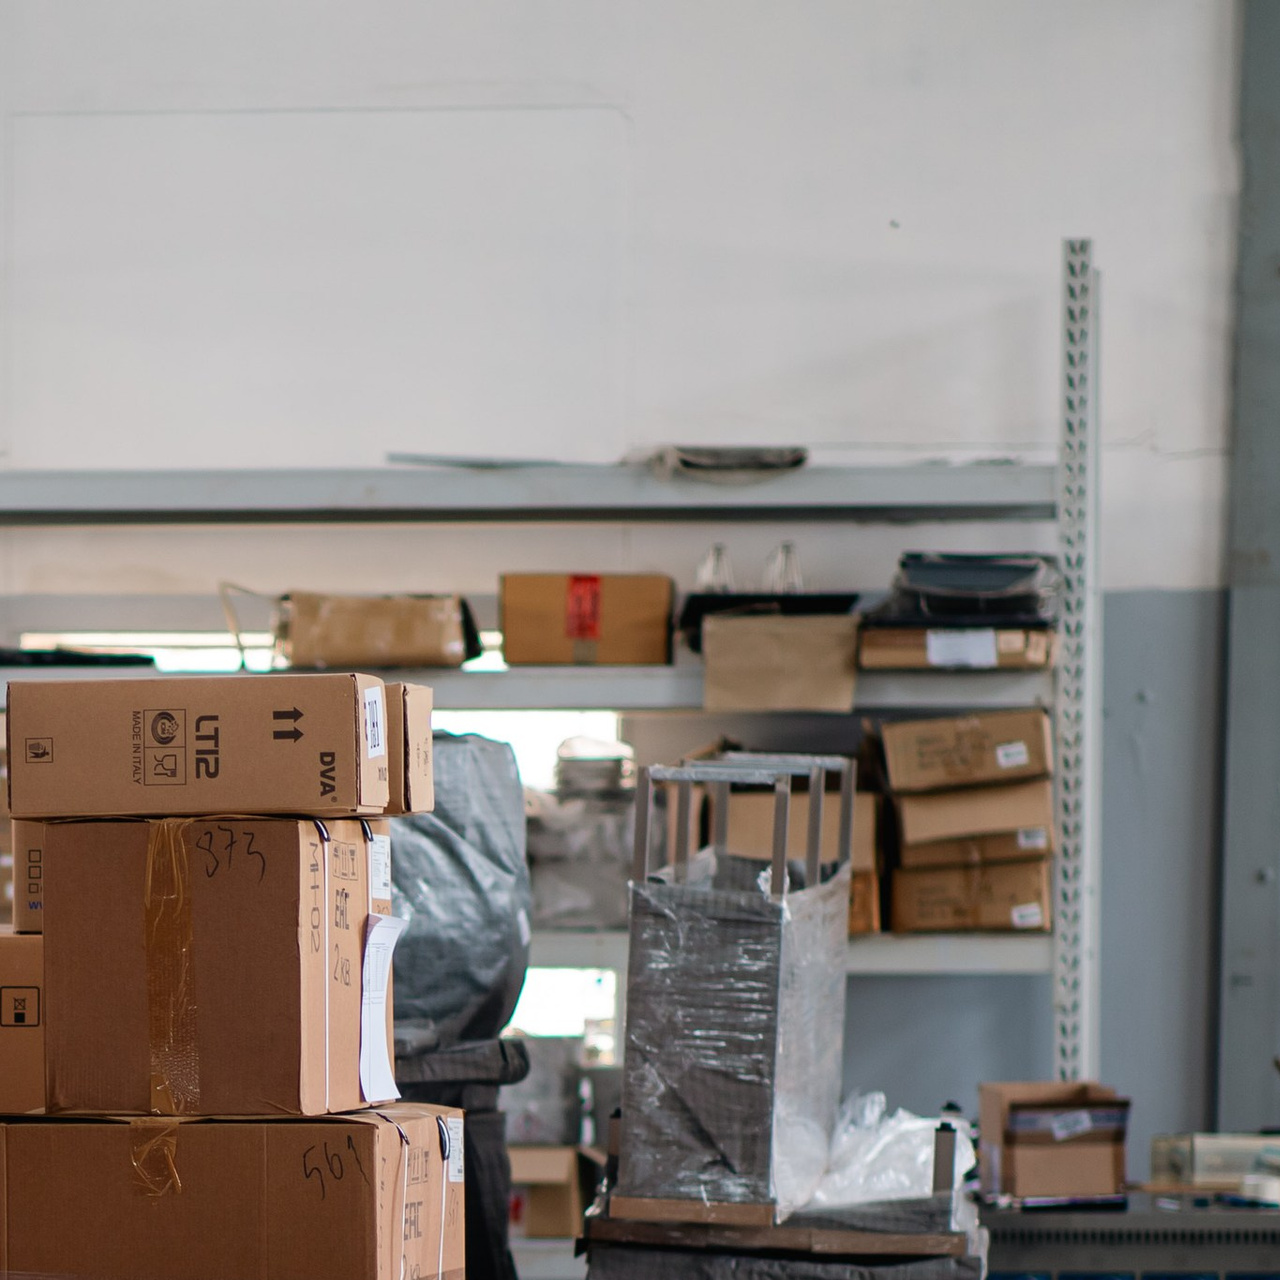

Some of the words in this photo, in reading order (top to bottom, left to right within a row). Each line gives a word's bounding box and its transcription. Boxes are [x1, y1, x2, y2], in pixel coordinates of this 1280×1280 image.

[132, 710, 142, 741] MADE
[132, 743, 142, 754] IN
[132, 755, 142, 785] ITALY
